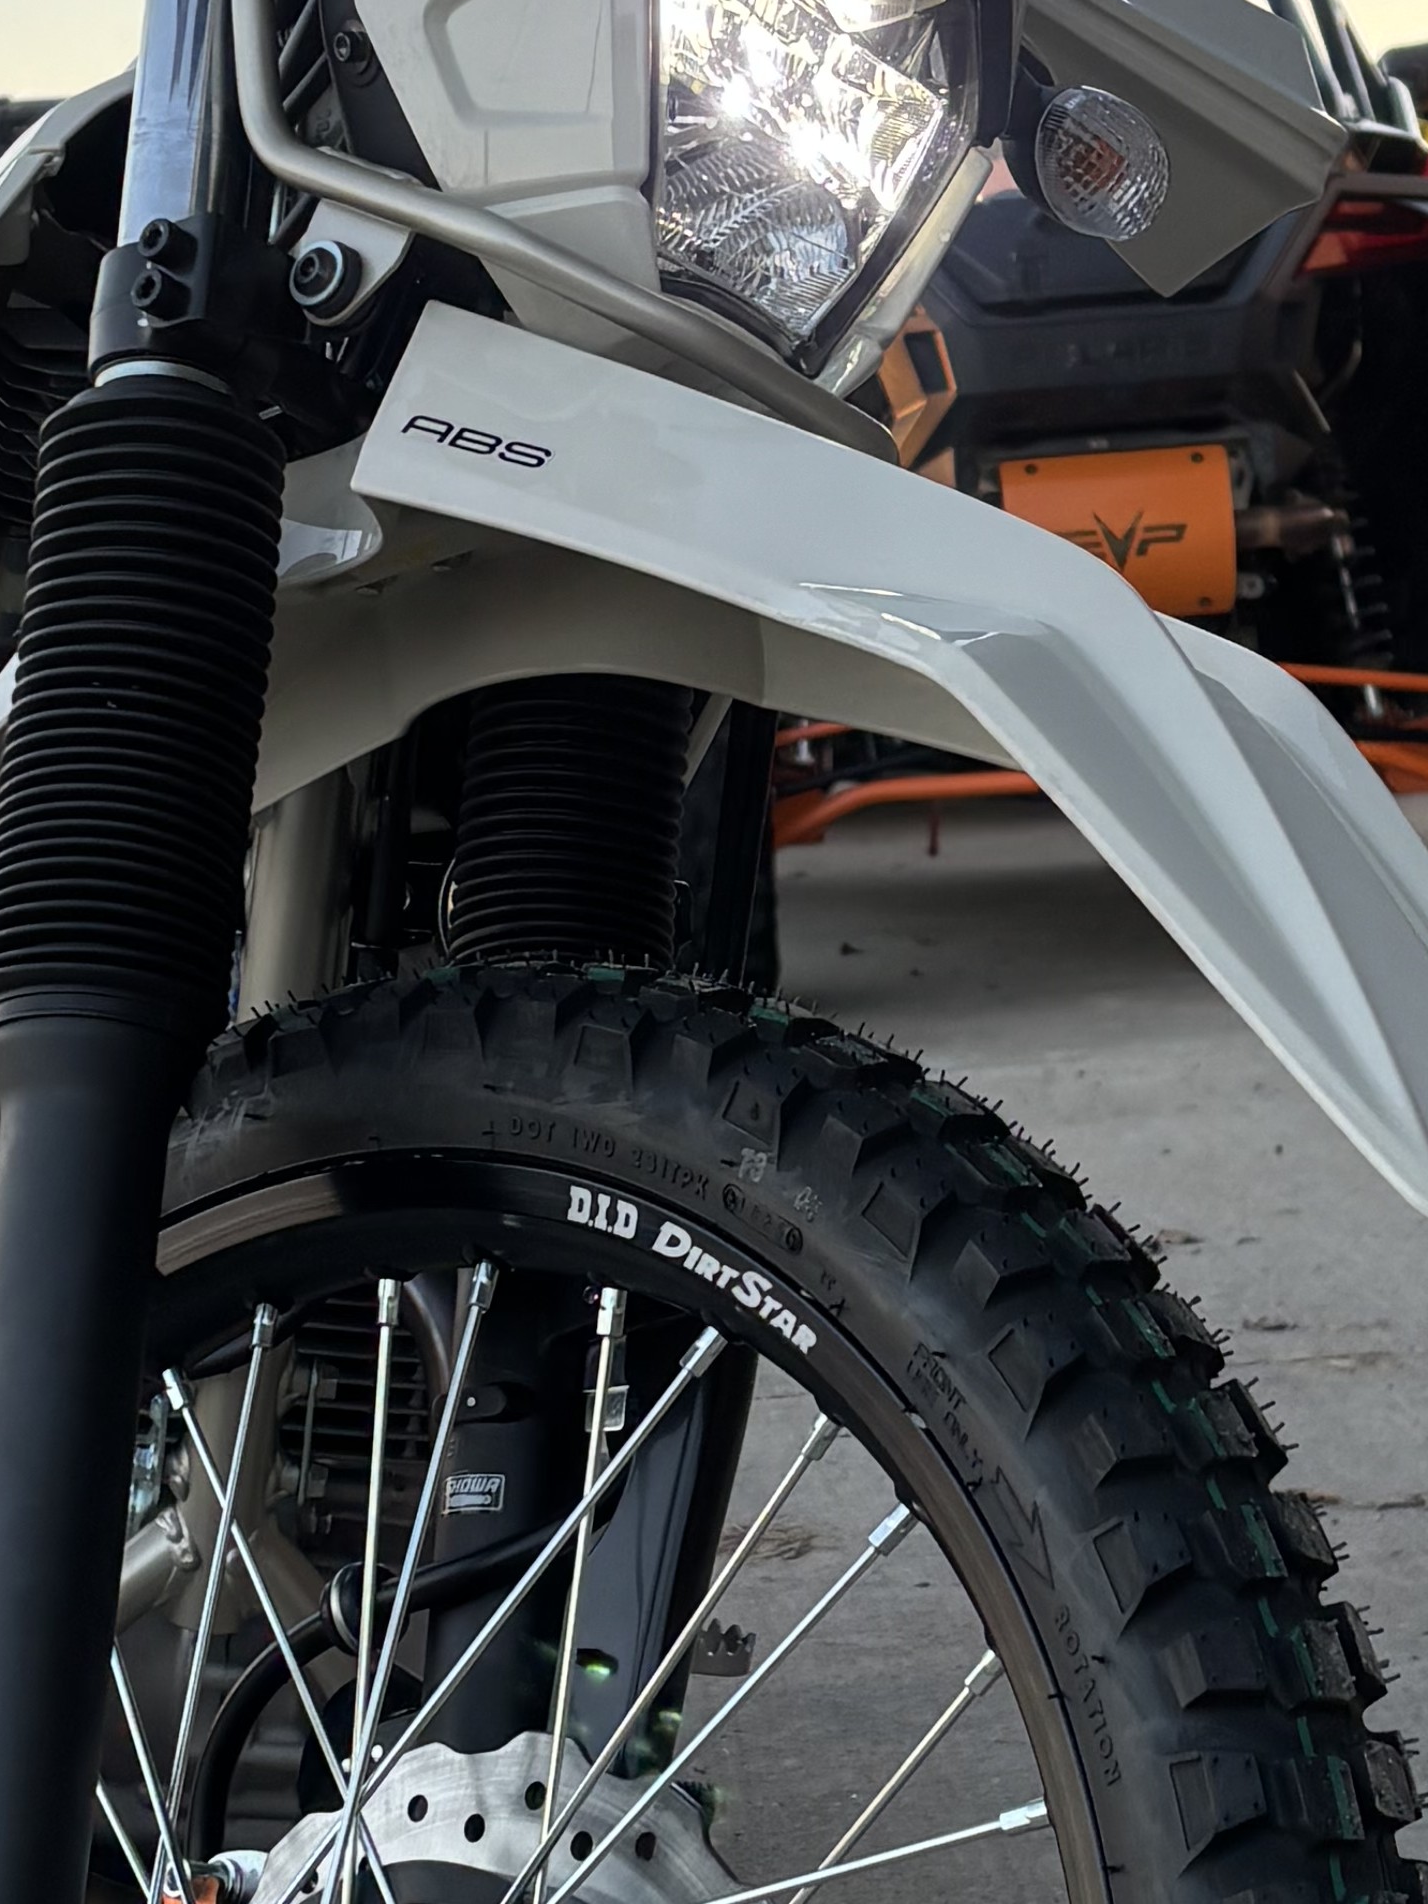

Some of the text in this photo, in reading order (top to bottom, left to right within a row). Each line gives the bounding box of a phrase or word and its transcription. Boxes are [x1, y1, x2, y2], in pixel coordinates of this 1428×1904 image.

[401, 413, 553, 469] ABS
[508, 1115, 557, 1143] DOT
[566, 1184, 639, 1241] D.I.D
[1054, 1605, 1122, 1786] ROTATION
